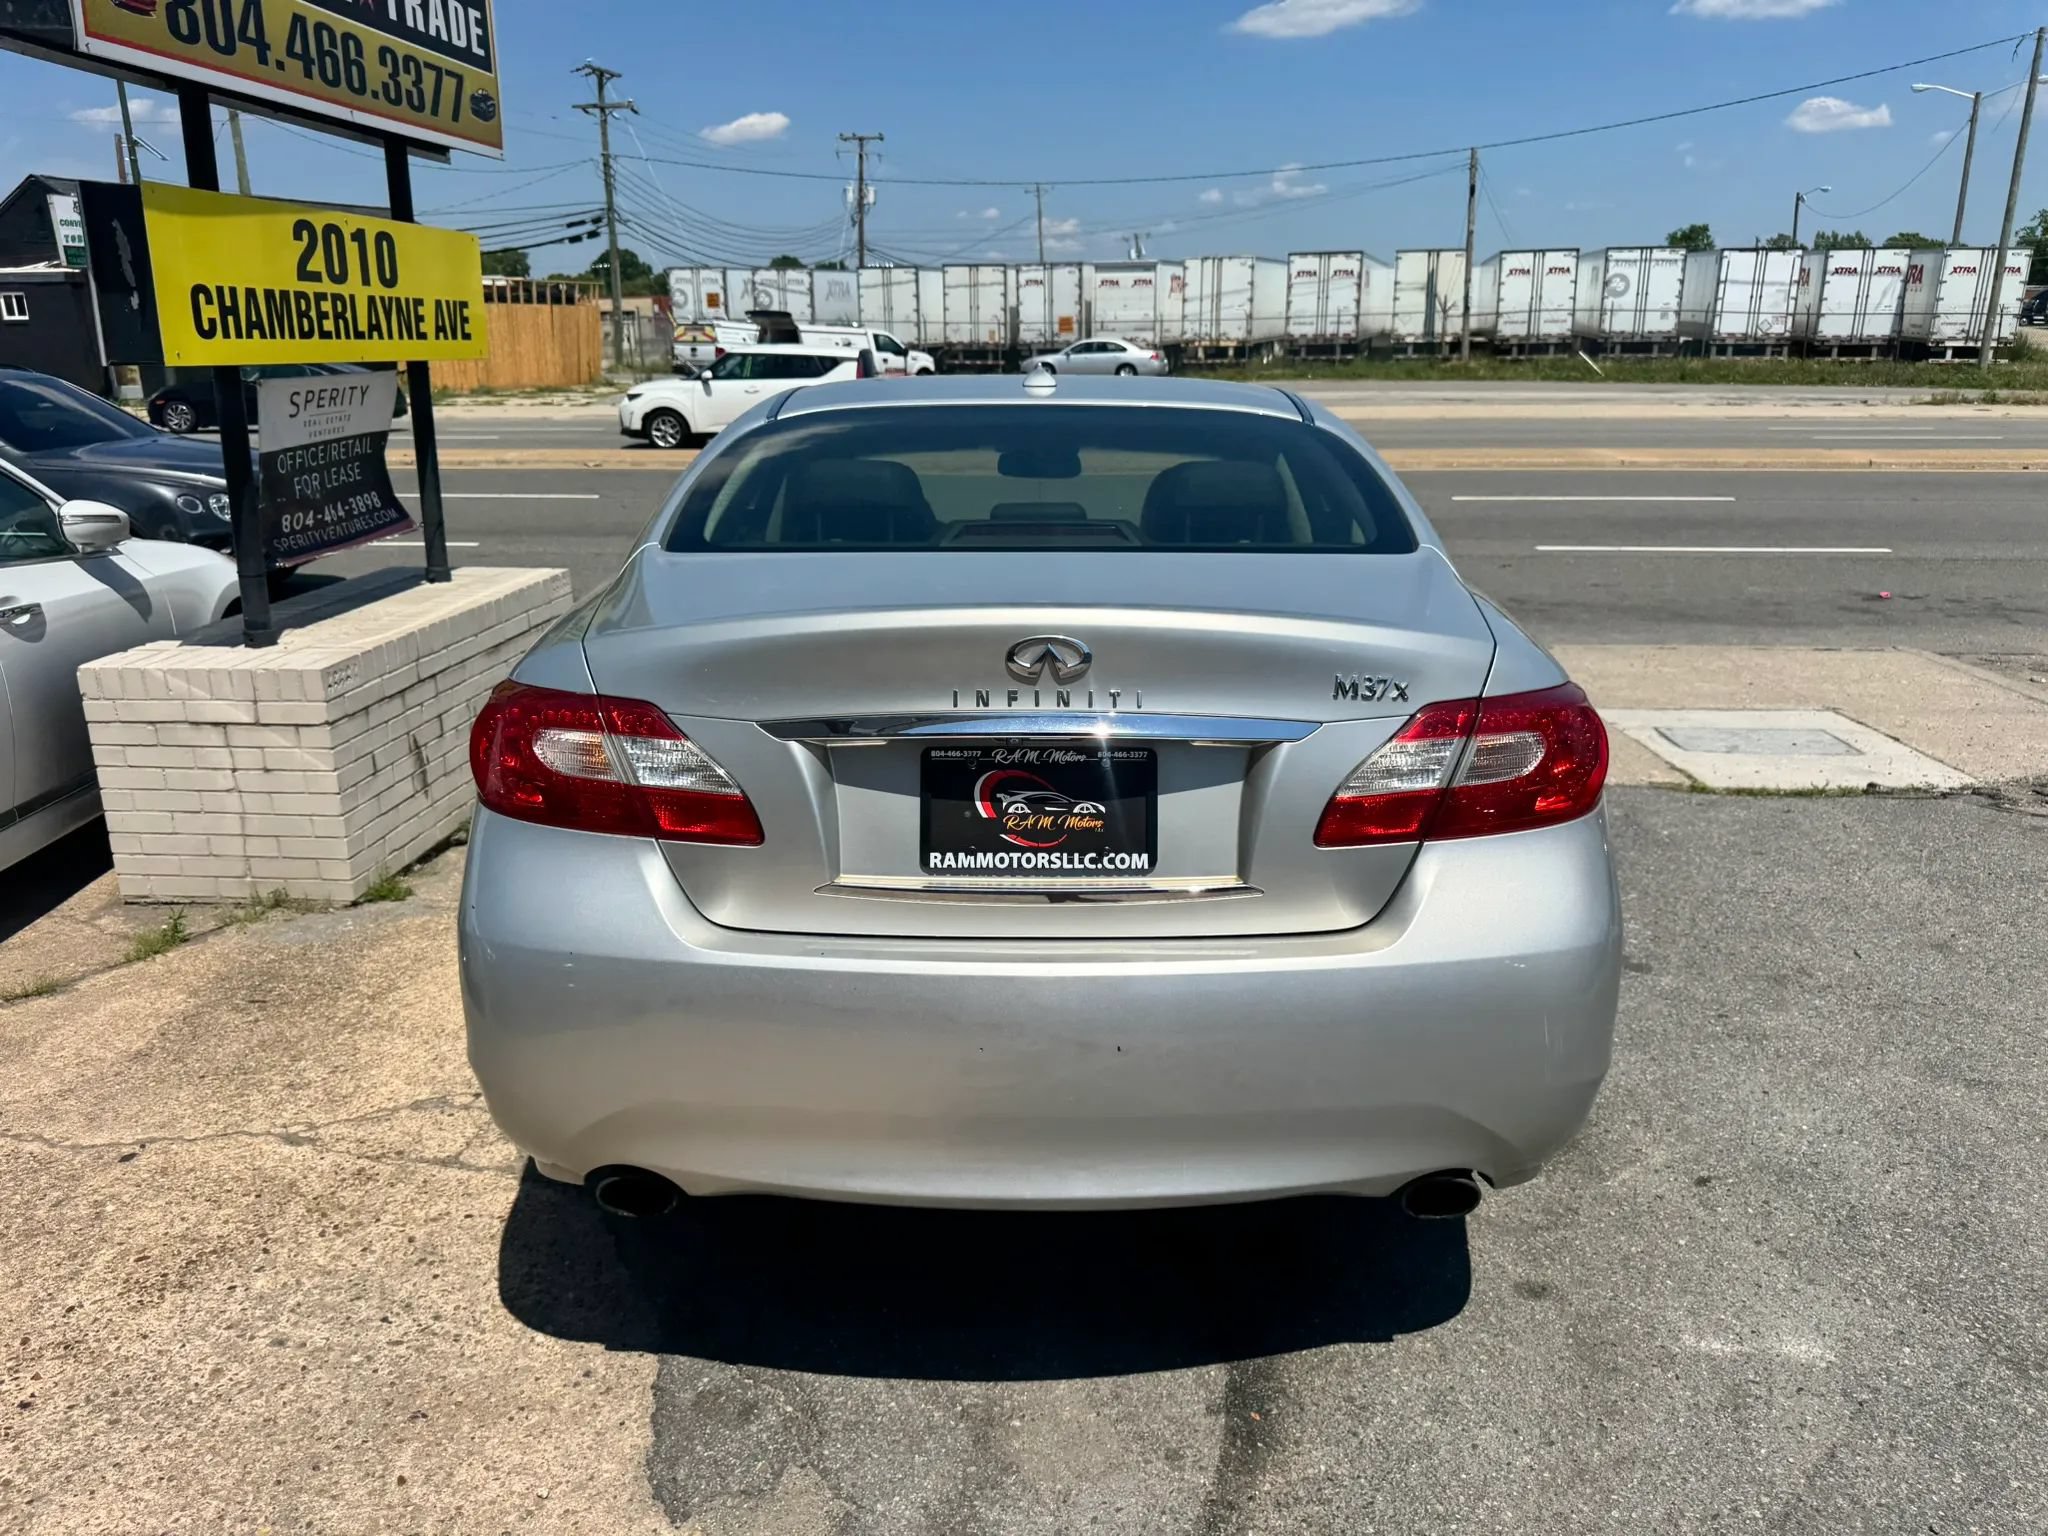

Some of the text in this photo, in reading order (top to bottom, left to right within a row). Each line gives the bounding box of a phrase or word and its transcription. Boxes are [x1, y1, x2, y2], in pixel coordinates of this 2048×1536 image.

[166, 0, 465, 123] 804.466.3377
[292, 218, 399, 289] 2010
[1294, 269, 1317, 279] XTRA
[1331, 268, 1354, 278] XTRA
[1506, 268, 1531, 277] XTRA
[1546, 266, 1571, 276] XTRA
[1830, 266, 1858, 276] XTRA
[1873, 265, 1902, 276] XTRA
[1948, 265, 1977, 276] XTRA
[2003, 265, 2022, 275] TRA
[190, 283, 472, 341] CHAMBERLAYNE AVE
[288, 384, 370, 419] SPERITY
[309, 425, 346, 439] VENTURES
[277, 436, 373, 474] OFFICE/RETAIL
[294, 462, 363, 499] FOR LEASE
[281, 491, 383, 533] 804-464-3898
[273, 508, 400, 552] SPERITYVENTURES.COM
[952, 688, 1143, 710] INFINITI
[930, 750, 982, 758] 804-466-3377
[991, 748, 1041, 764] RAM
[1043, 748, 1087, 765] Motors
[1002, 813, 1105, 831] RAM Motors
[929, 852, 1149, 869] RAMMOTORSLLC.COM
